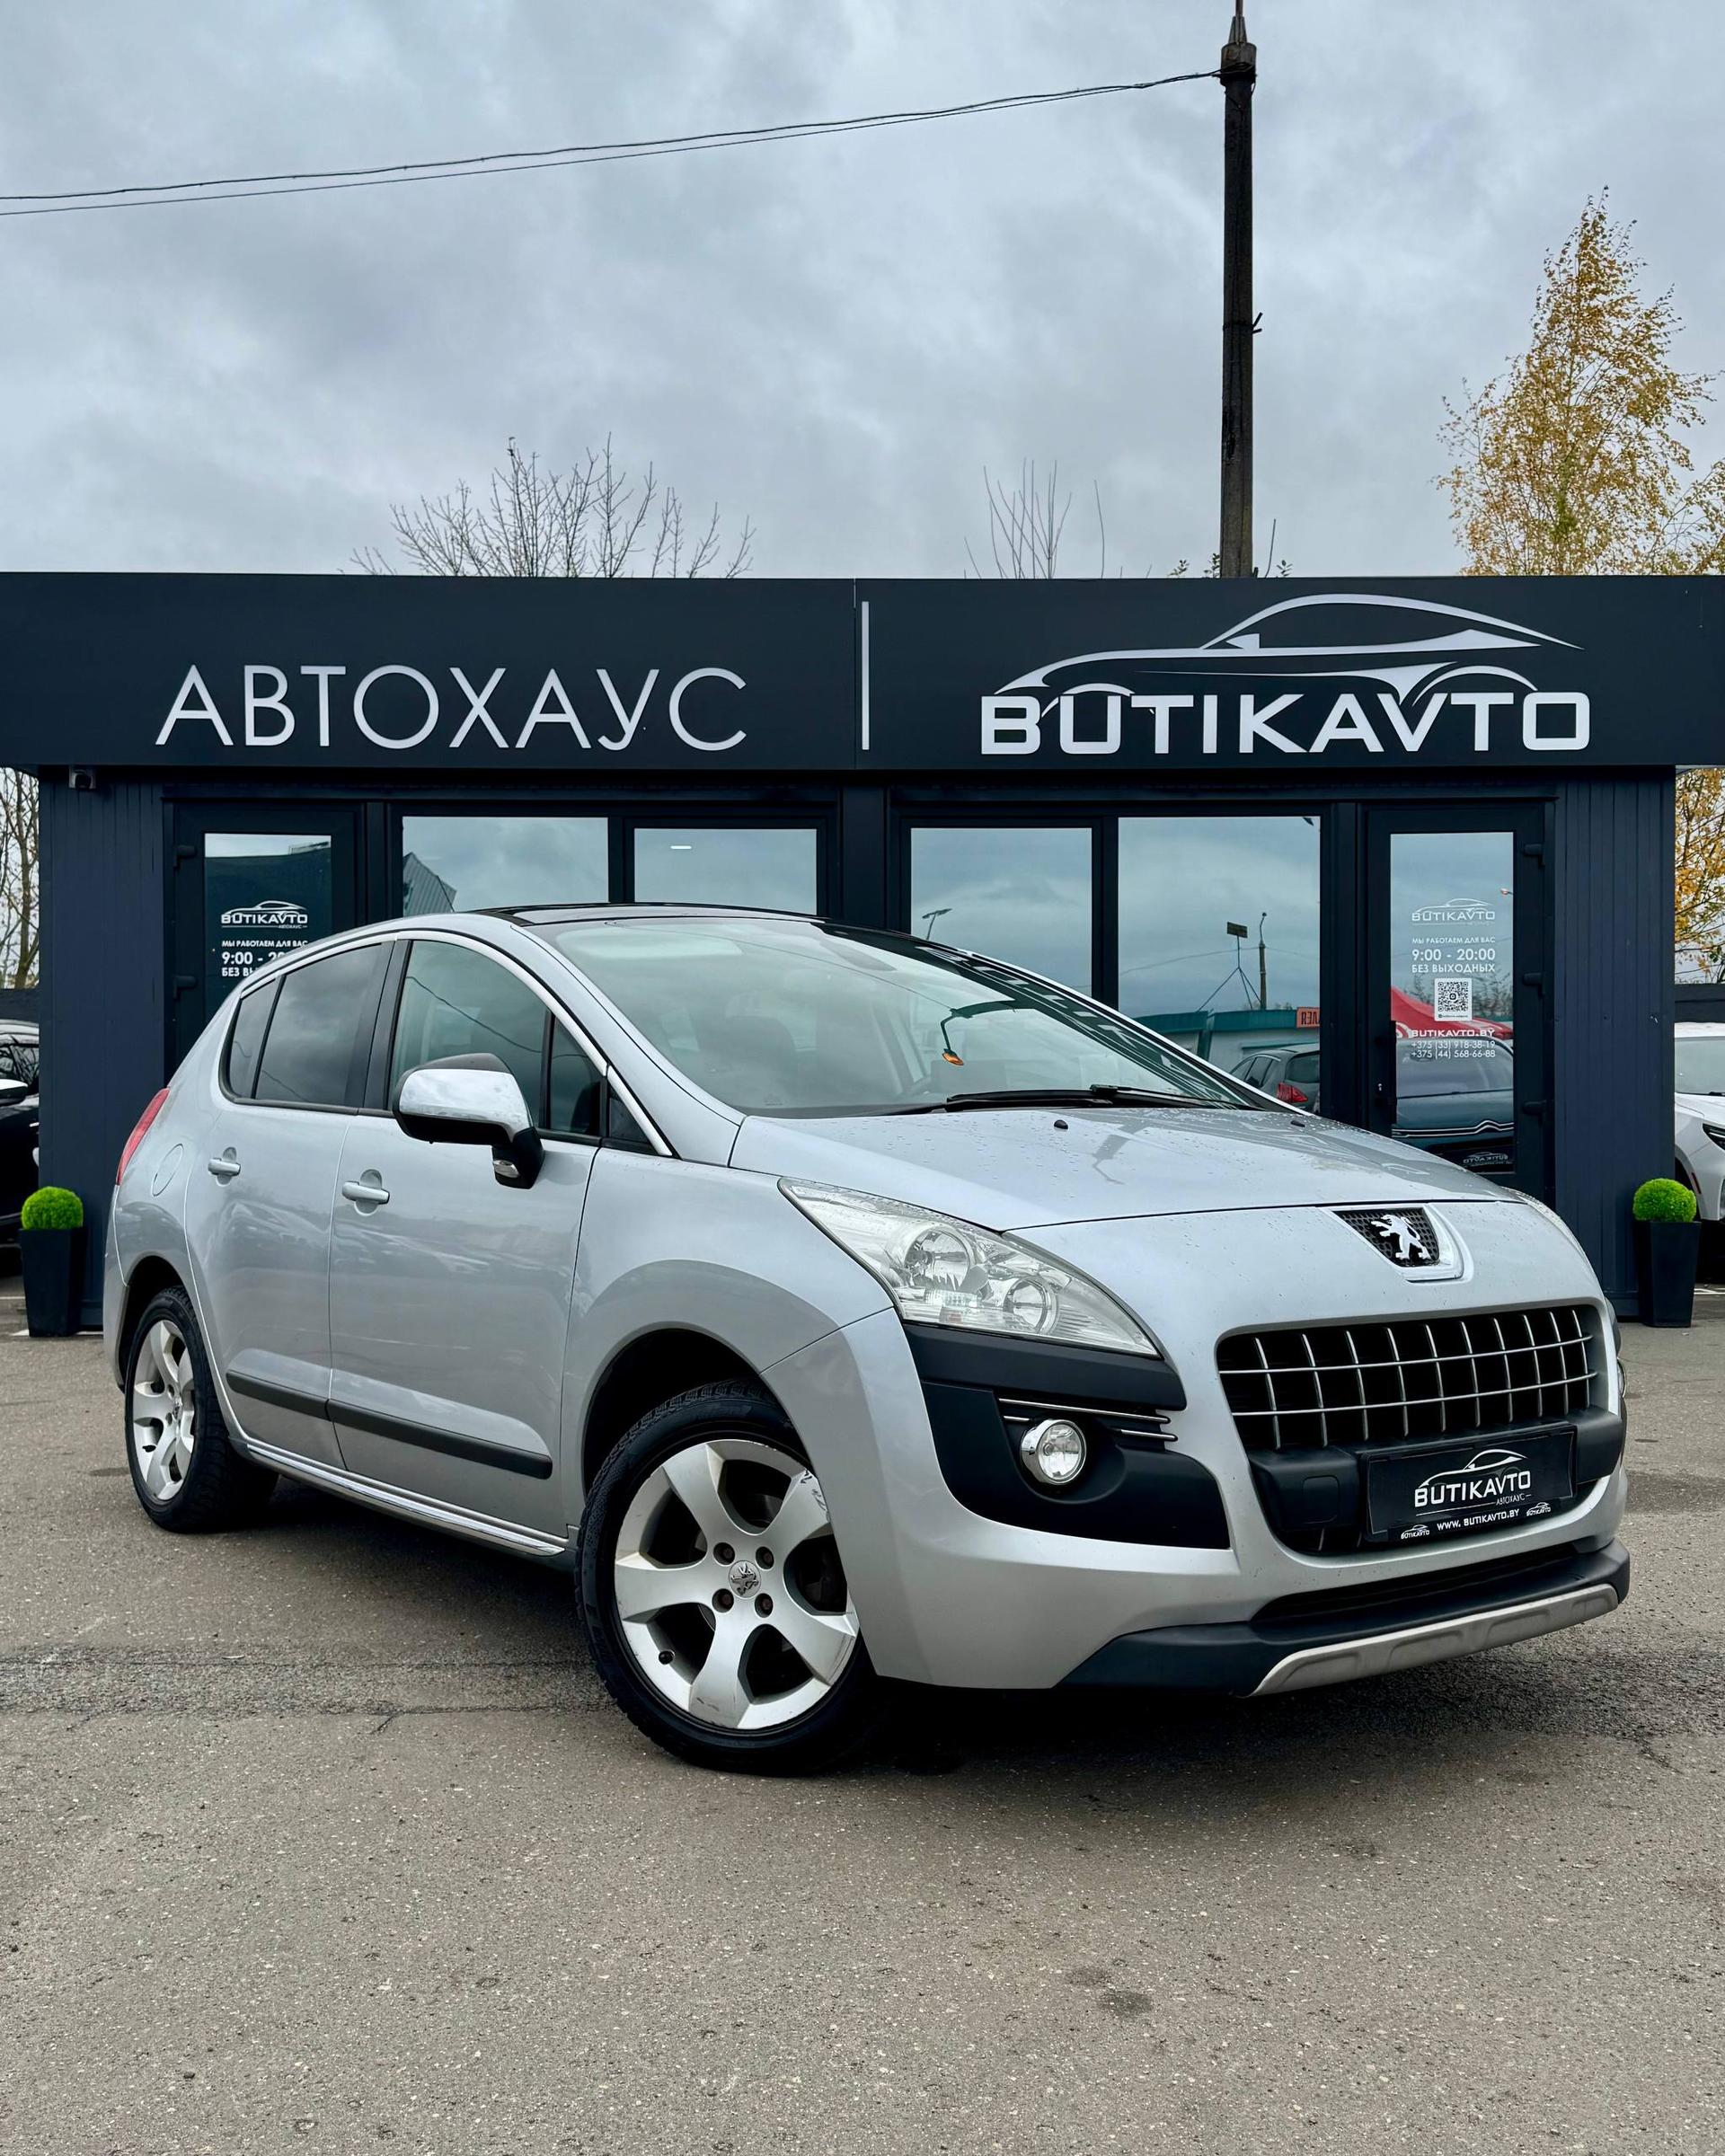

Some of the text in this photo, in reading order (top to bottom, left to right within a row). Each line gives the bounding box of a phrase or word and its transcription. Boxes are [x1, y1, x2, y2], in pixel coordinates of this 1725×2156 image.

[155, 664, 747, 751] АВТОХАУС
[980, 692, 1590, 755] BUTIKAVTO
[221, 914, 307, 923] BUTIKAVTO
[1411, 912, 1496, 922] BUTIKAVTO
[222, 951, 252, 965] 9:00
[1412, 949, 1441, 960] 9:00
[1457, 949, 1495, 960] 20:00
[222, 968, 239, 976] БЕЗ
[1412, 964, 1495, 973] БЕЗ ВЫХОДНЫХ
[1412, 1029, 1495, 1037] BUTIKAVTO.BY
[1411, 1040, 1496, 1049] +375 (33) 918-38-19
[1436, 1049, 1451, 1059] (44)
[1414, 1471, 1531, 1507] BUTIKAVTO
[1438, 1508, 1520, 1531] WWW. BUTIKAVTO.BY
[1401, 1530, 1430, 1539] BUTIKAVTO
